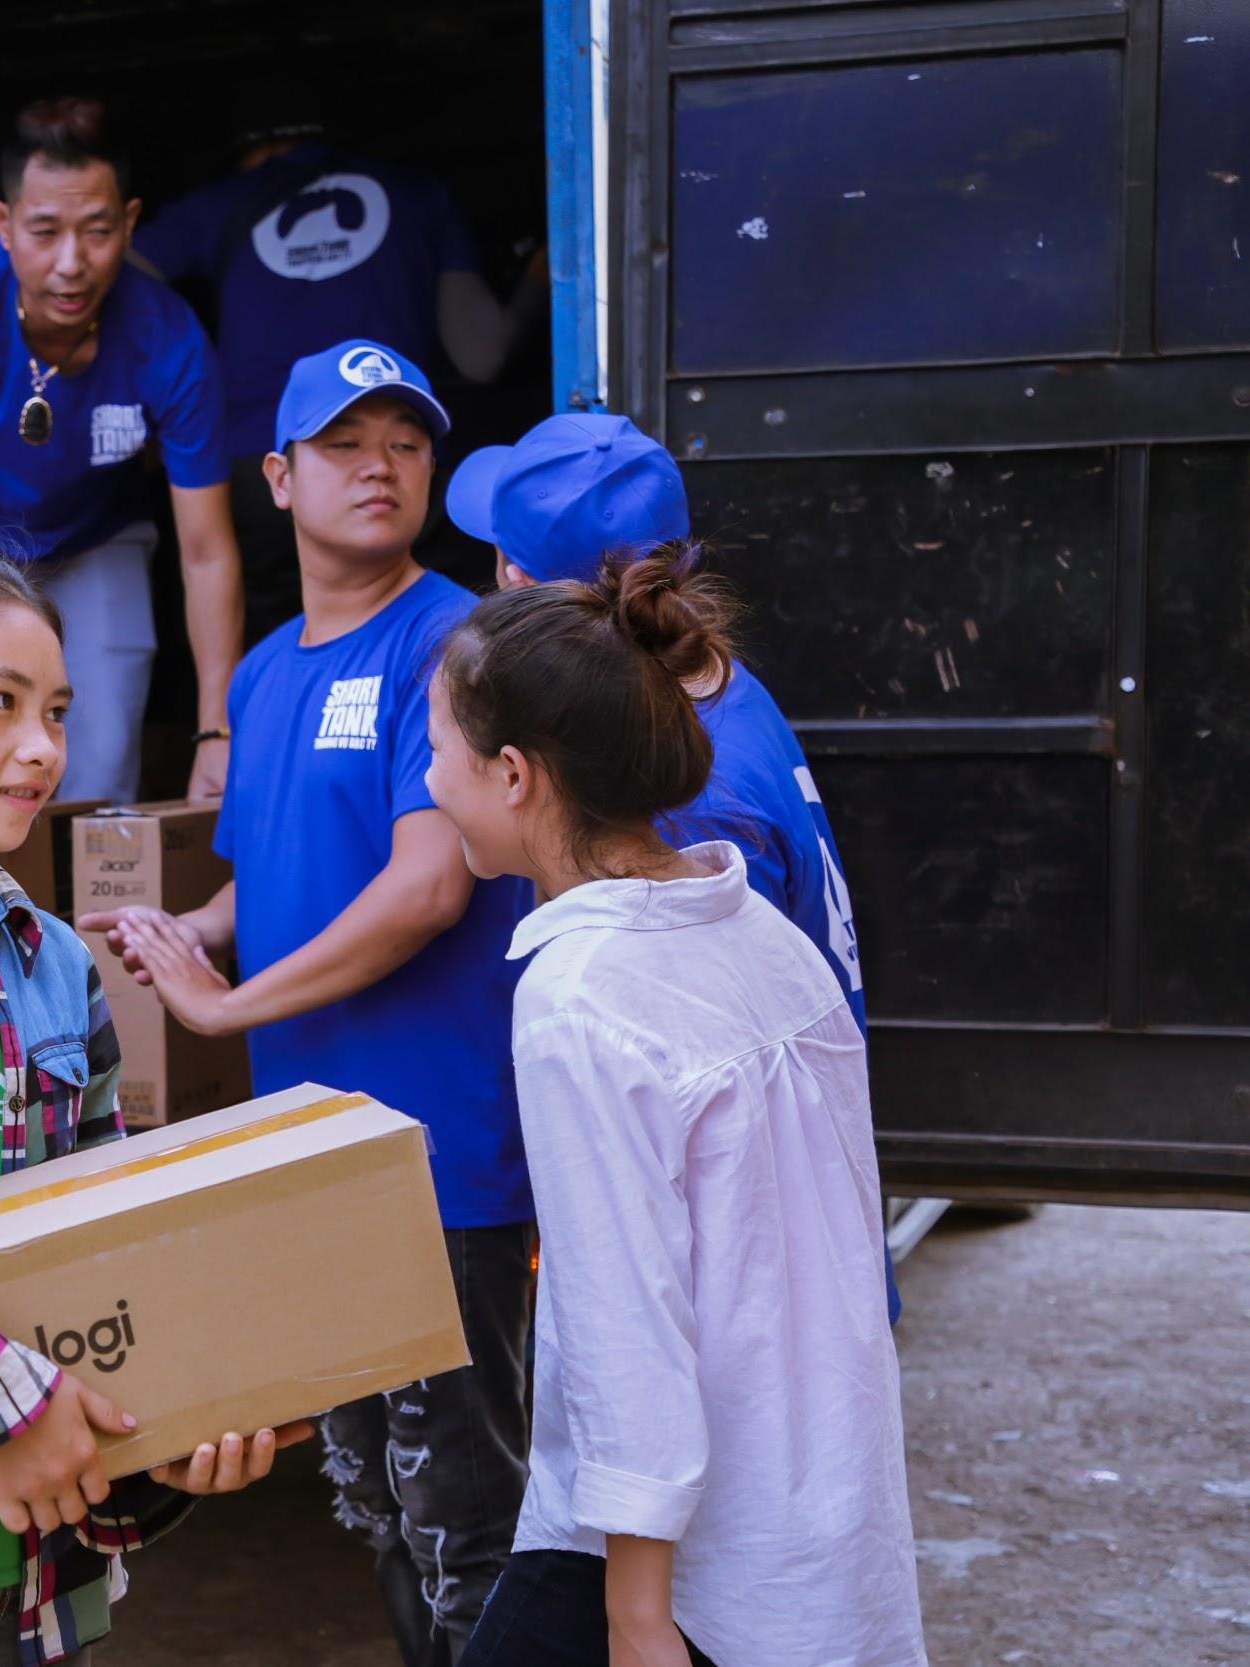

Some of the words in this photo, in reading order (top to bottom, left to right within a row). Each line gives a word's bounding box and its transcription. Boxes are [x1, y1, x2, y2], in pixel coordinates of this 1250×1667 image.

[318, 704, 379, 738] TANK
[99, 860, 140, 873] acer
[90, 881, 112, 896] 20
[34, 1299, 136, 1373] logi
